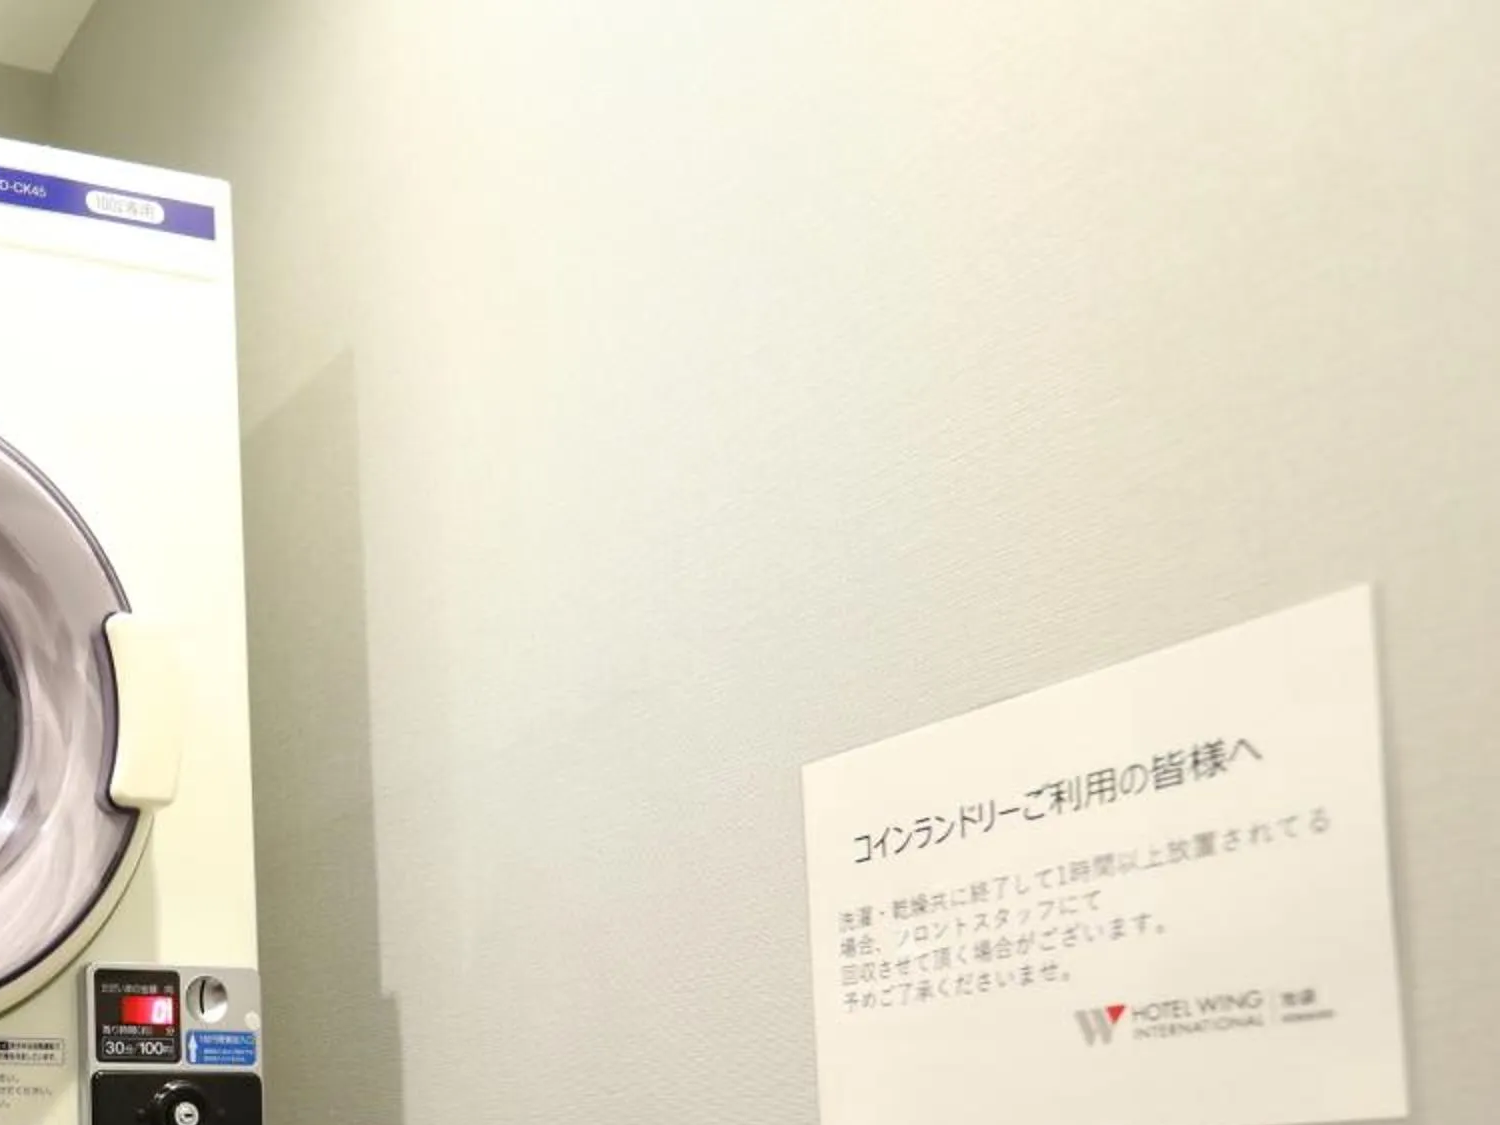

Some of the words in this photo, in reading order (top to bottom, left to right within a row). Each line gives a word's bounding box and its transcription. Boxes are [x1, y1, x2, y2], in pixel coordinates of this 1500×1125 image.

[854, 735, 1263, 864] コインランドリーご利用の皆様へ
[1132, 999, 1191, 1022] HOTEL
[1196, 990, 1264, 1014] WING
[1133, 1015, 1264, 1041] INTERNATIONAL
